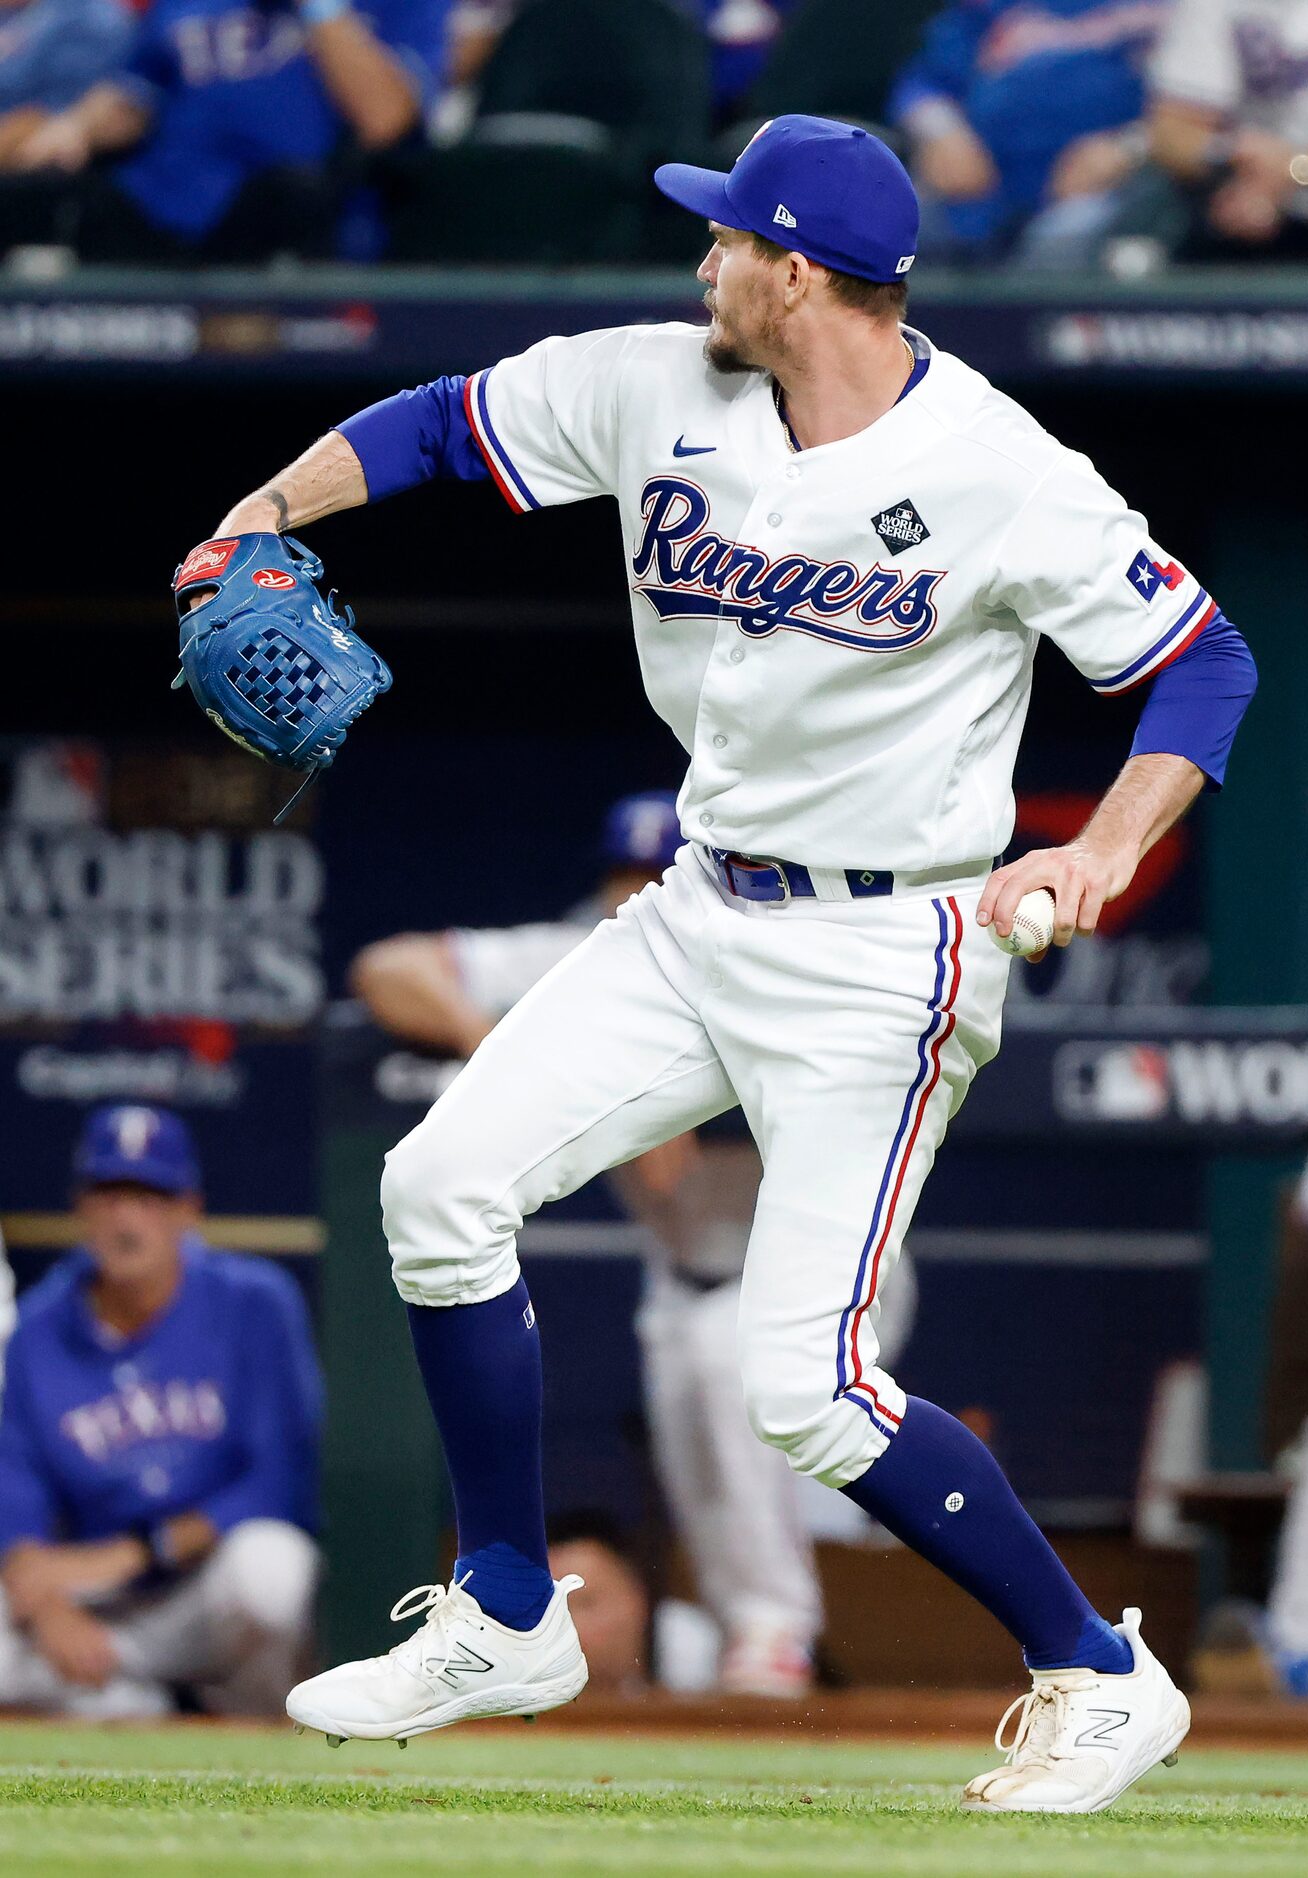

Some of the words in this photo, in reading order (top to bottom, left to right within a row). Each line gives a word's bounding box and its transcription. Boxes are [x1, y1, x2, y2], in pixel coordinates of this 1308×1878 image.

[877, 523, 922, 544] SERIES
[880, 513, 924, 534] WORLD
[633, 476, 949, 653] Rangers
